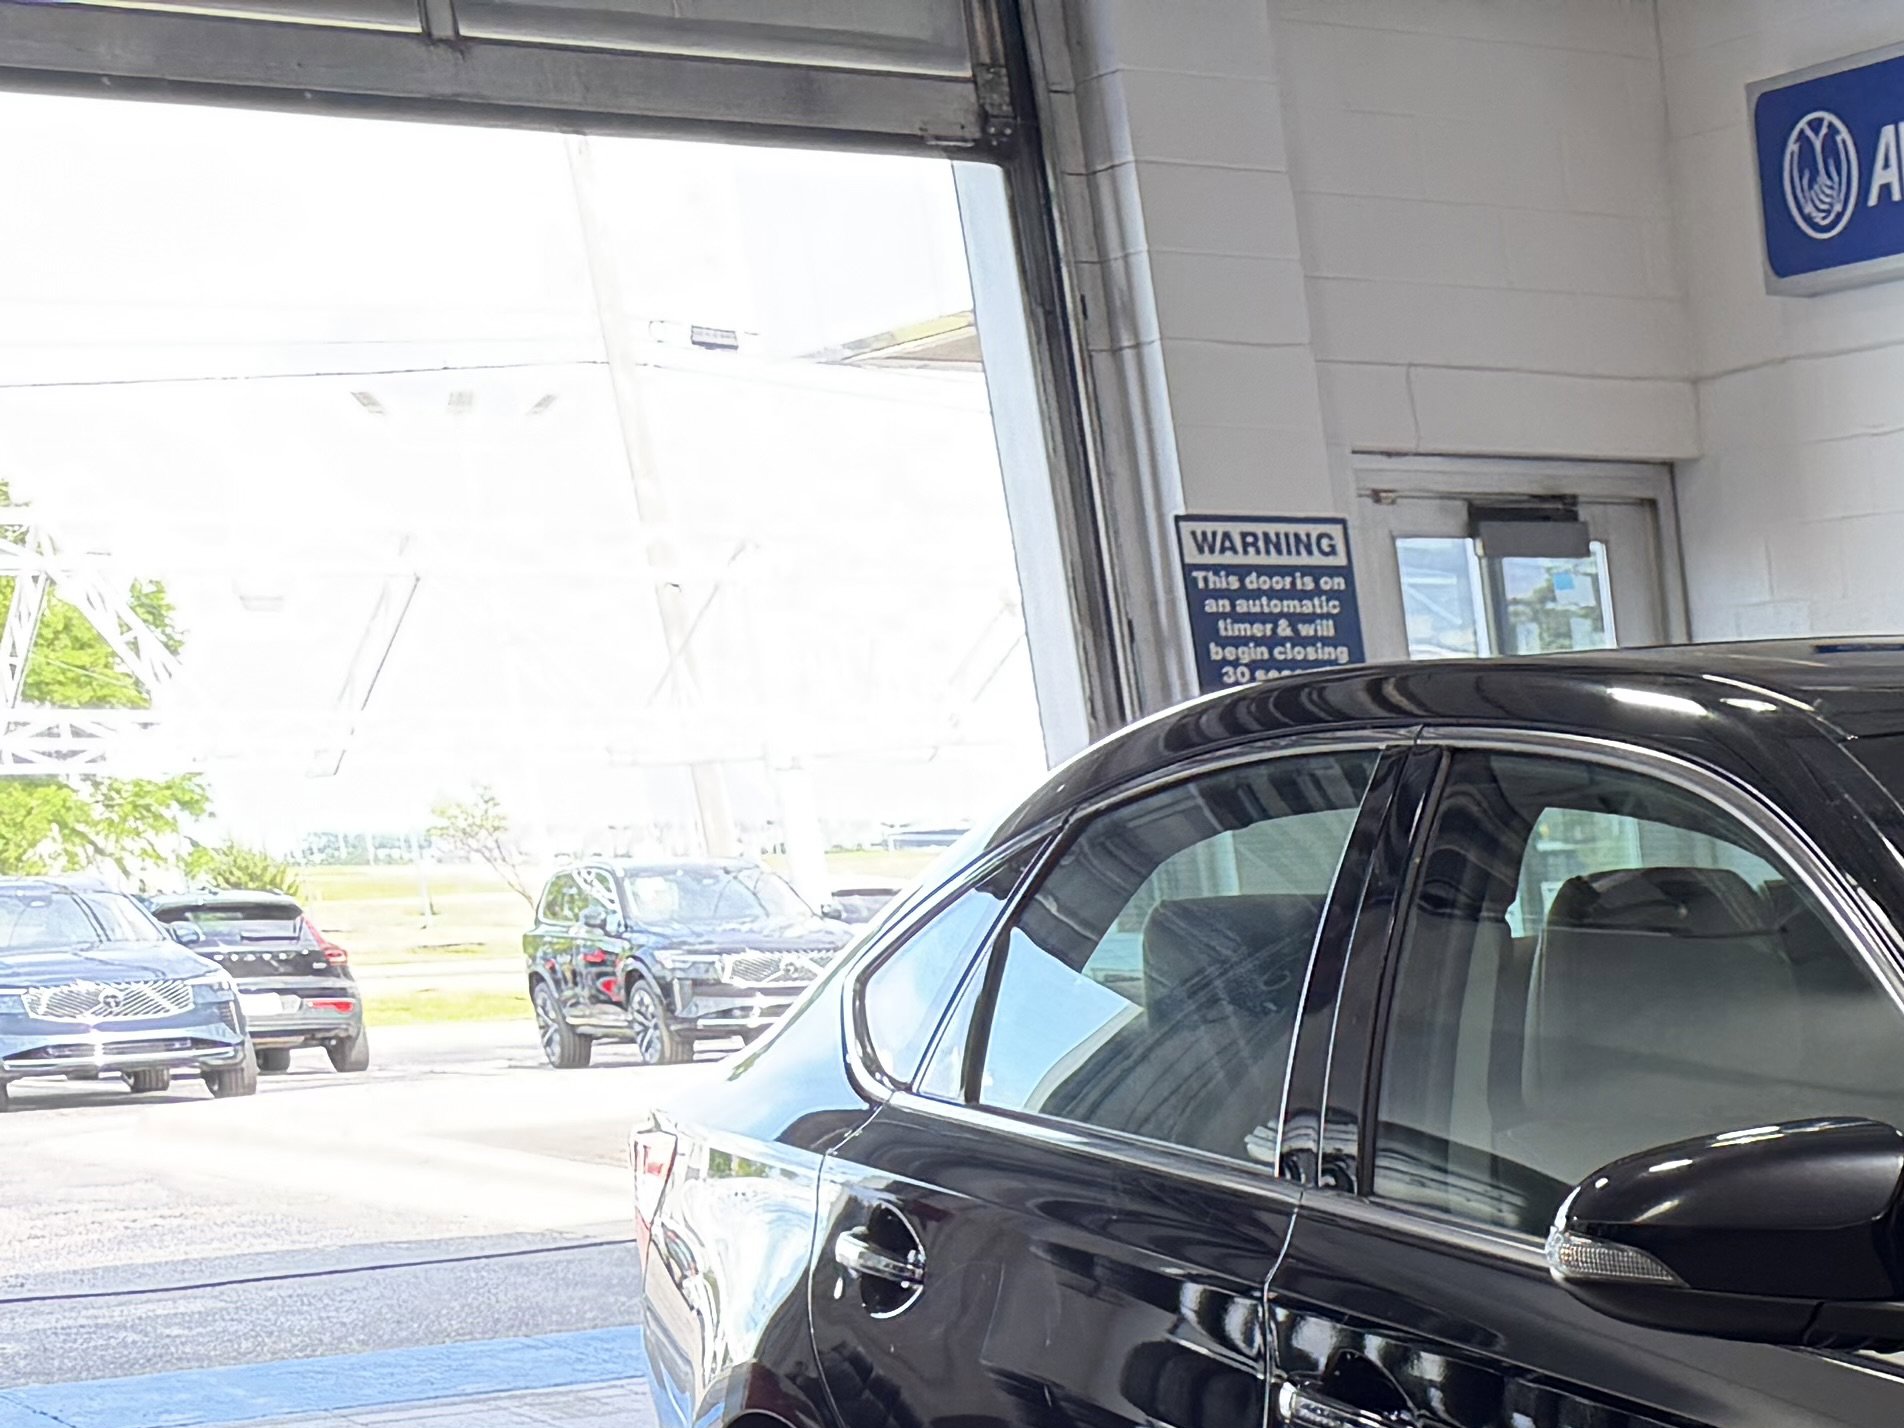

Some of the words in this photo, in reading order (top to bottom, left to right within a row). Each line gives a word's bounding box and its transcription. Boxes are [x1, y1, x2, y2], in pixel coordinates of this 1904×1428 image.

[1190, 530, 1338, 557] WARNING
[1192, 570, 1240, 590] This
[1244, 570, 1292, 591] door
[1294, 571, 1315, 591] is
[1319, 576, 1346, 591] on
[1204, 598, 1231, 613] an
[1235, 595, 1341, 614] automatic
[1218, 618, 1273, 637] timer
[1276, 617, 1295, 637] &
[1298, 619, 1335, 637] will
[1209, 642, 1270, 663] begin
[1273, 642, 1349, 663] closing
[1221, 665, 1251, 684] 30
